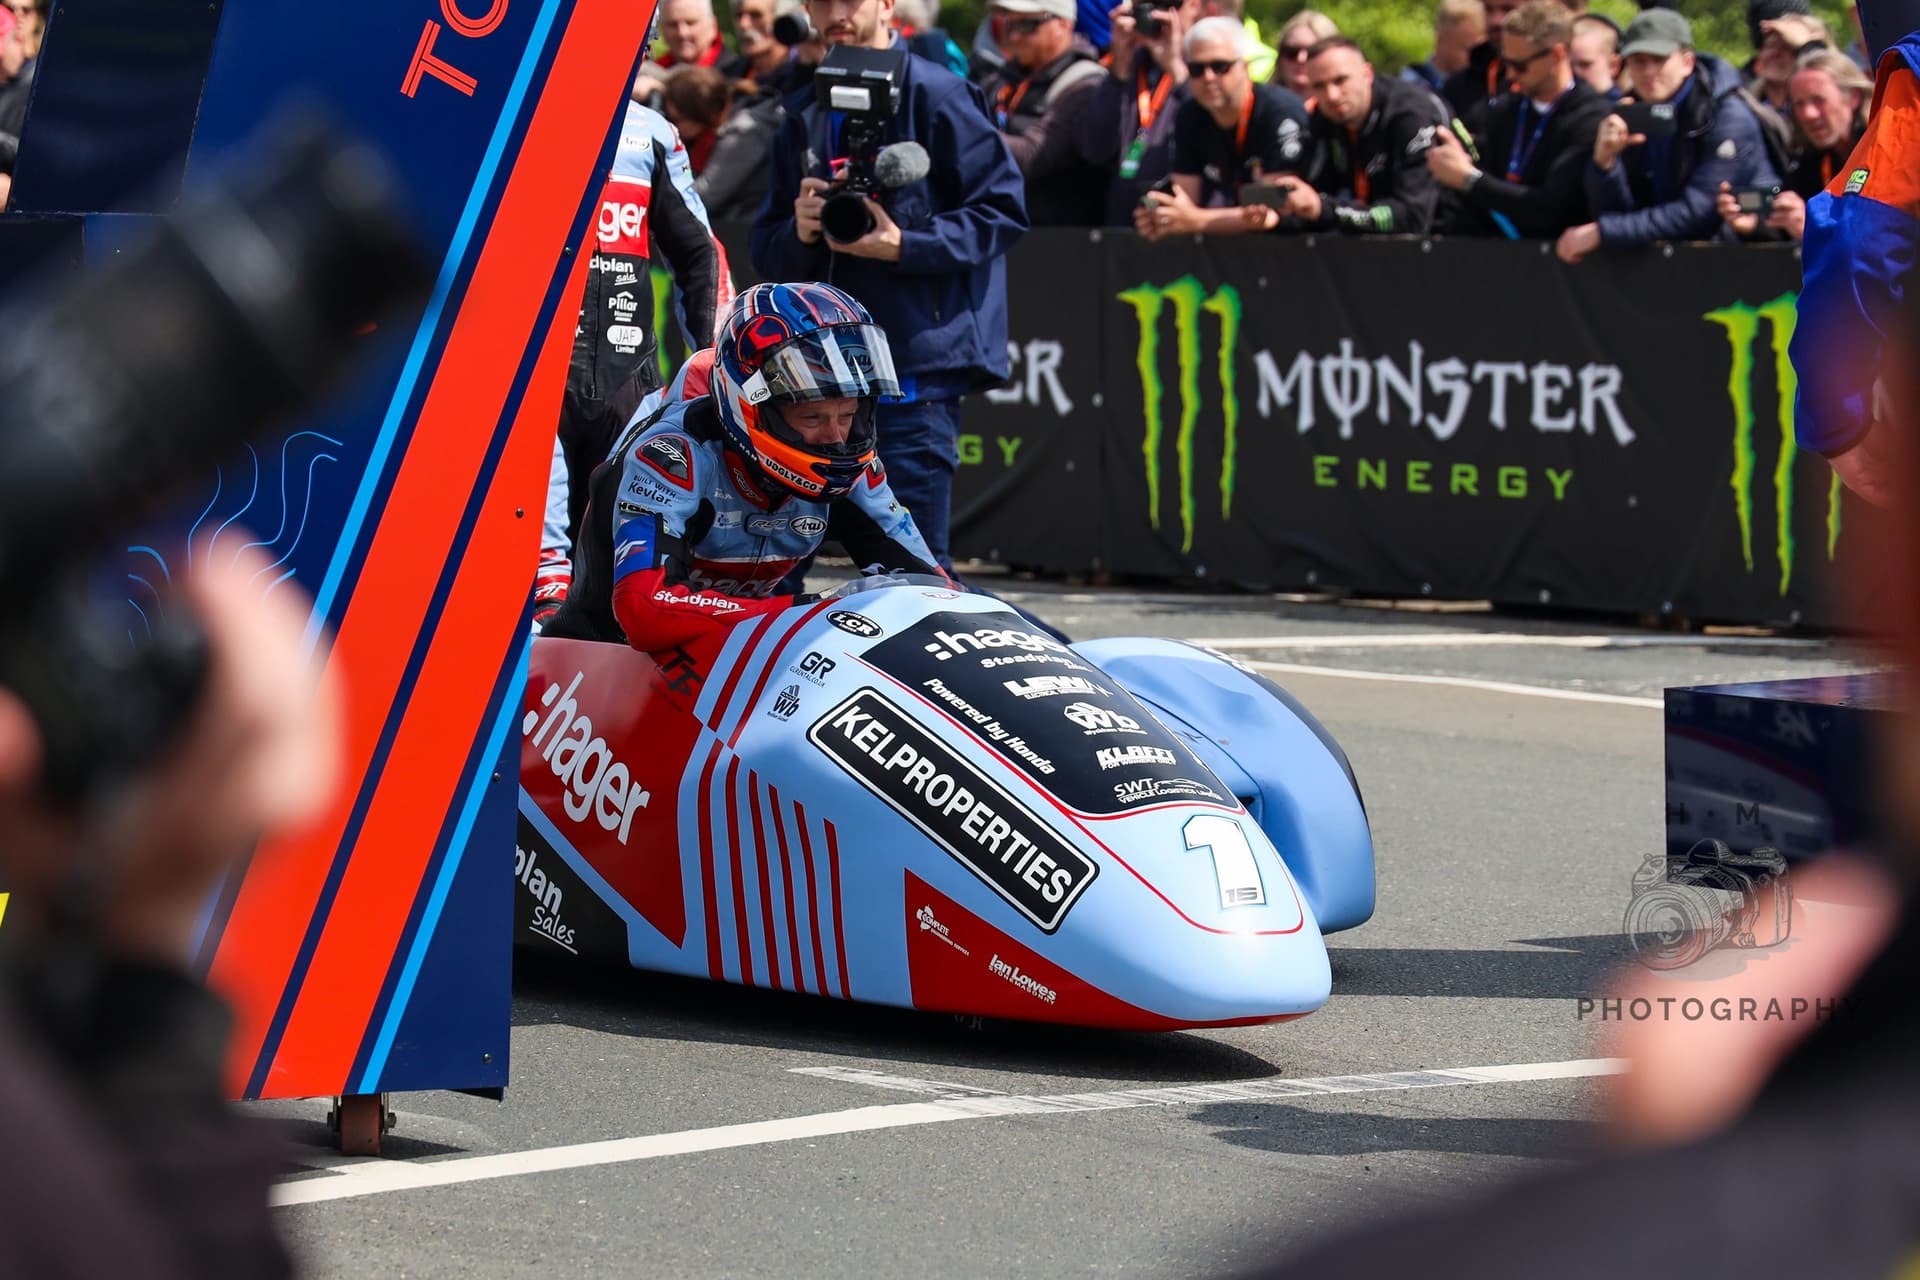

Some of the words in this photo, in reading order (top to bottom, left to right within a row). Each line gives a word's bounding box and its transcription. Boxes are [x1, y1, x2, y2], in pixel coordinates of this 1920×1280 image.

[597, 201, 647, 243] ger
[1253, 337, 1636, 446] MONSTER
[628, 481, 672, 507] Kevlar
[654, 482, 677, 500] WITH
[1312, 454, 1574, 501] ENERGY
[800, 516, 822, 531] Arai
[833, 613, 875, 637] LCR
[799, 651, 836, 681] GR
[923, 677, 992, 726] Powered
[984, 719, 1010, 742] by
[1004, 734, 1057, 776] Honda
[832, 705, 1073, 904] KELPROPERTIES
[1113, 777, 1154, 798] SWT
[1181, 813, 1267, 910] 1
[1224, 886, 1258, 904] 15
[531, 906, 576, 946] Sales
[989, 953, 1012, 977] Ian
[1011, 966, 1058, 1001] Lowes
